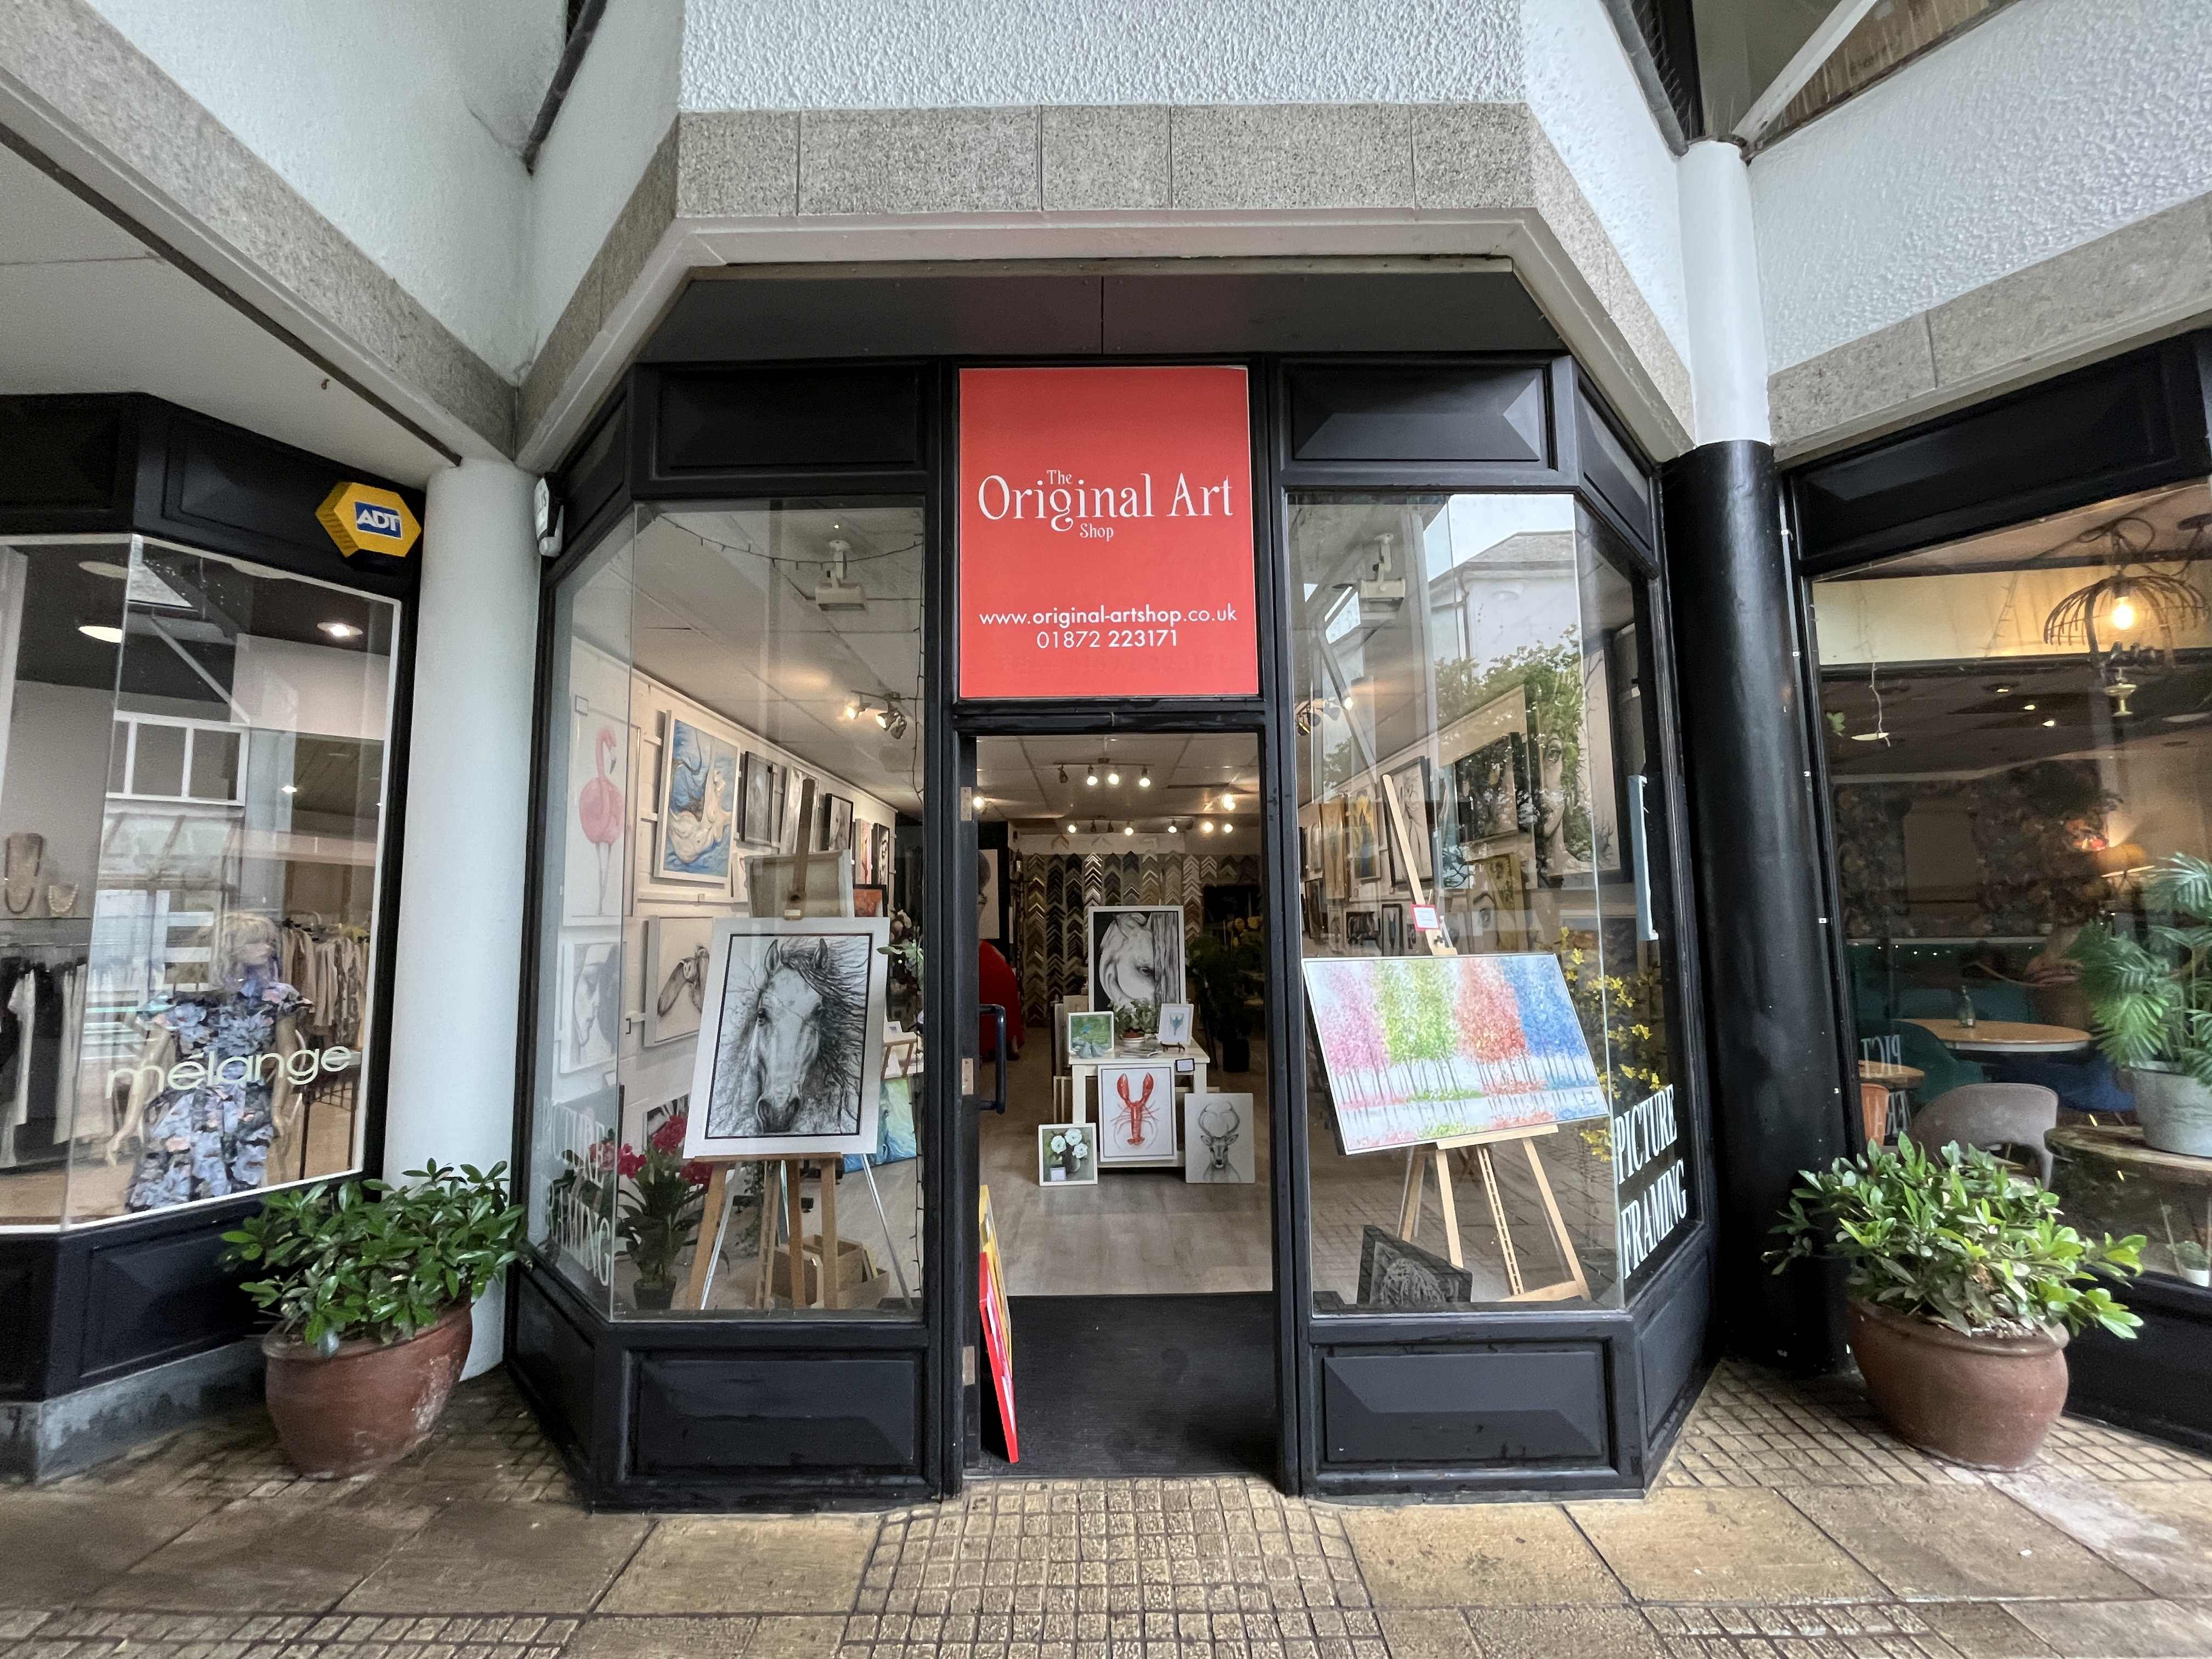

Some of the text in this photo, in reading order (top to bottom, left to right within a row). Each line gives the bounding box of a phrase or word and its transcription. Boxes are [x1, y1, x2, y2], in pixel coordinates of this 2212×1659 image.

[1046, 470, 1073, 484] The
[978, 472, 1233, 532] Original Art
[357, 509, 400, 531] ADT
[1079, 523, 1114, 541] Shop
[979, 603, 1237, 628] www.original-artshop.co.uk
[1037, 629, 1177, 649] 01872 223171
[106, 1045, 352, 1099] mélange
[1615, 1083, 1677, 1185] PICTURE
[1620, 1158, 1687, 1280] FRAMING
